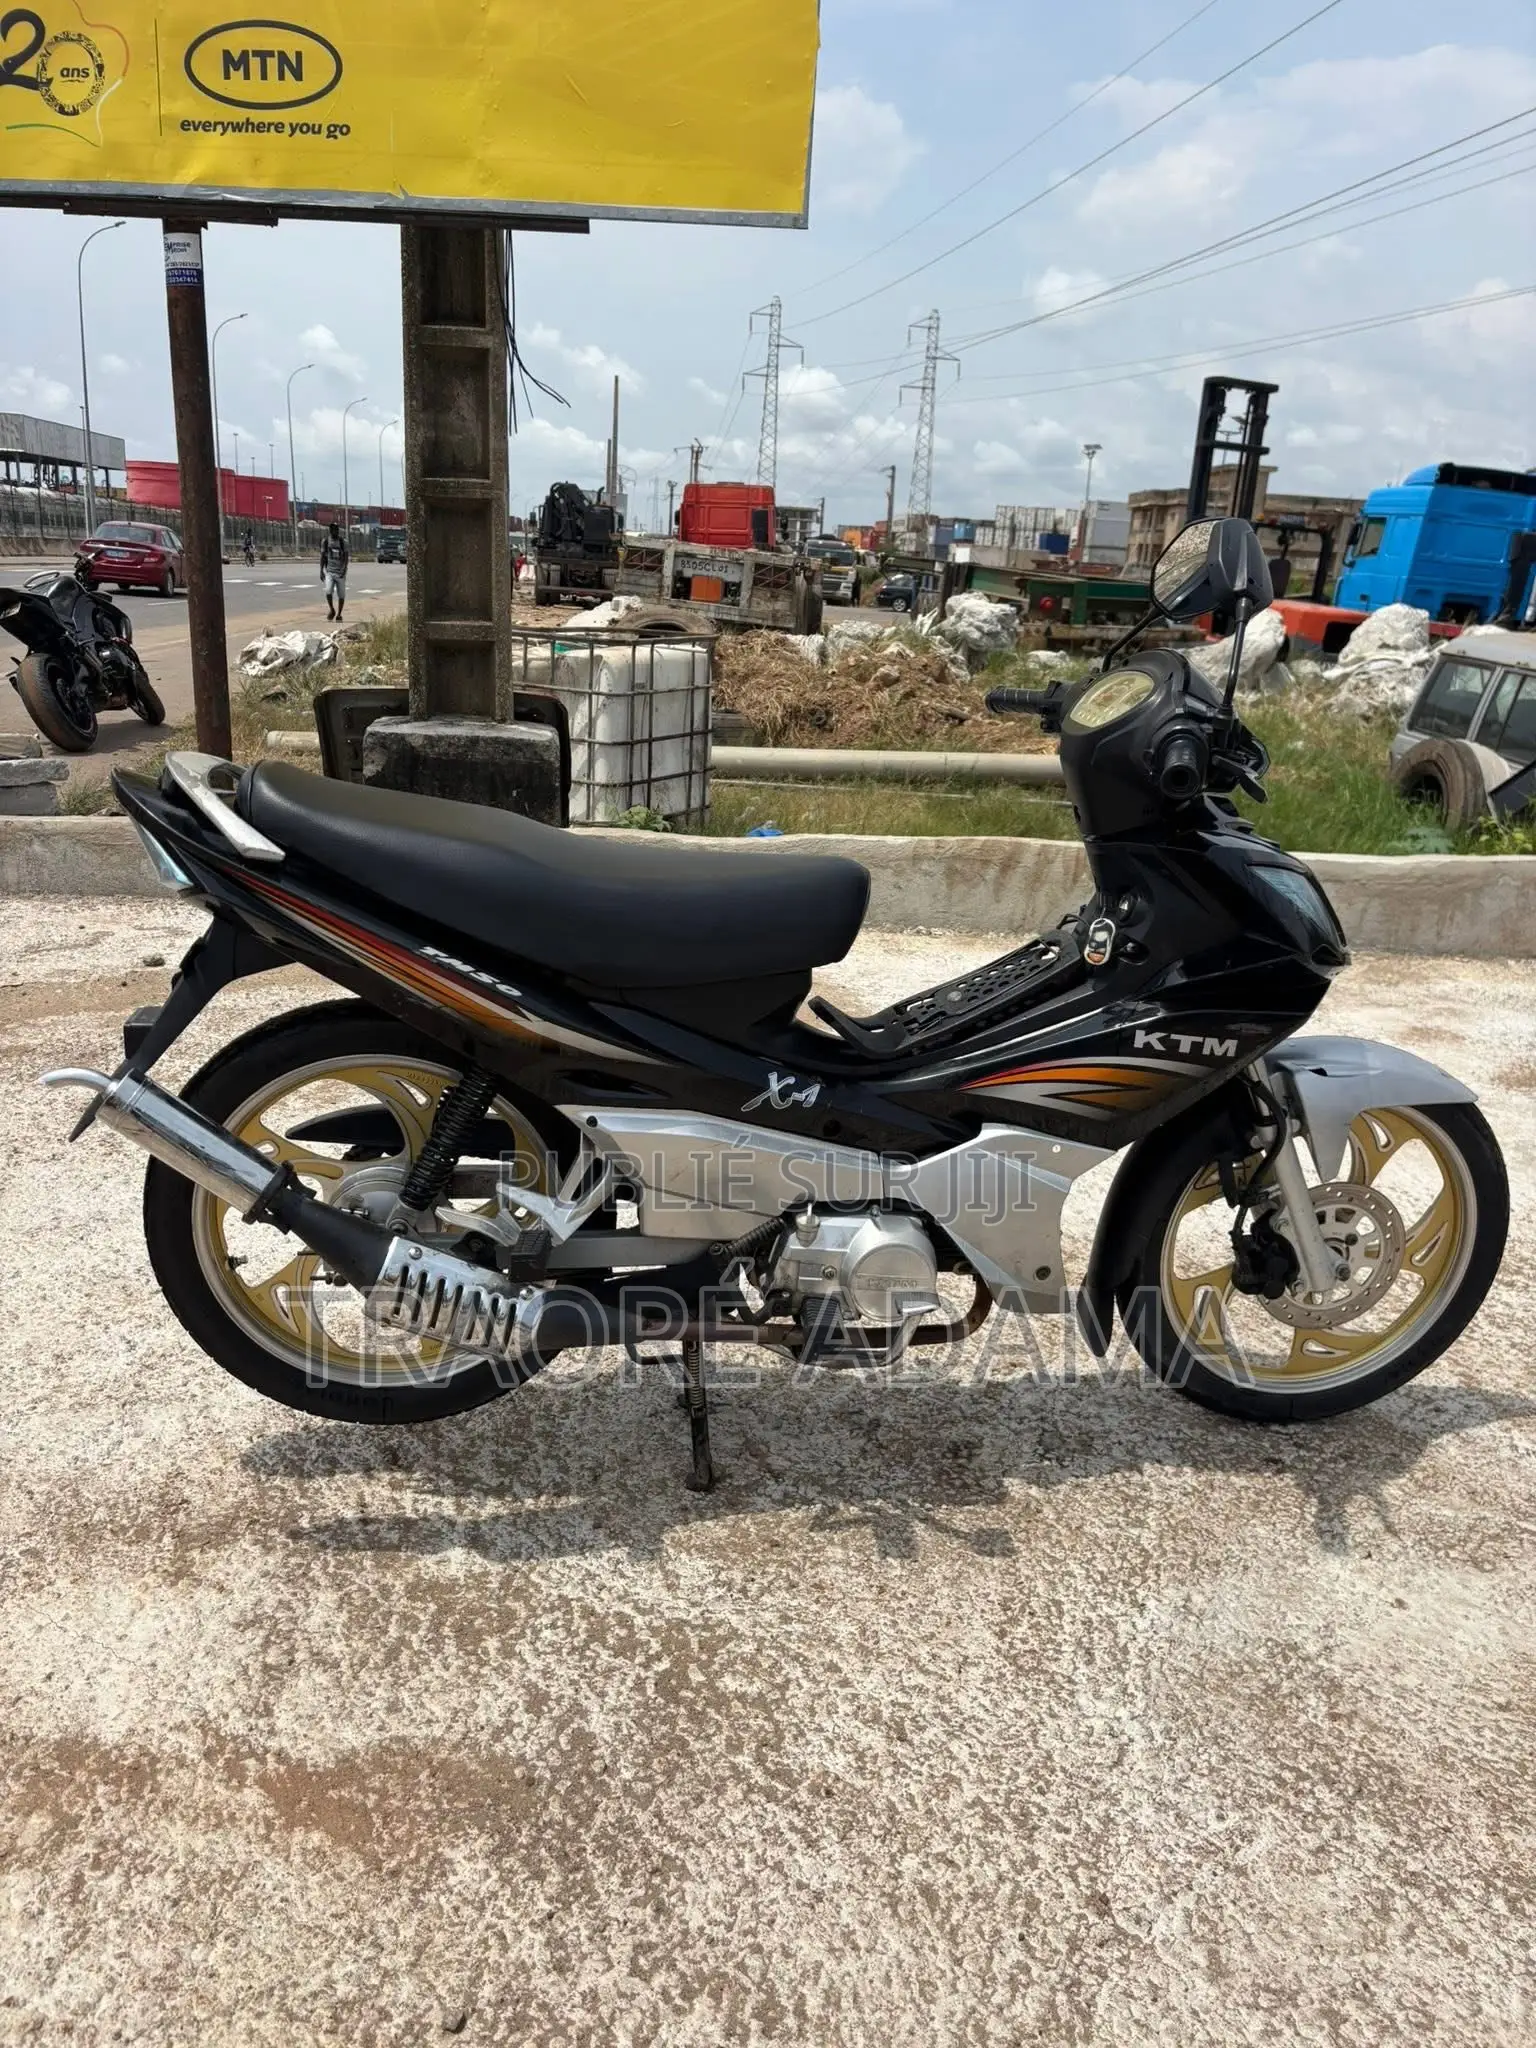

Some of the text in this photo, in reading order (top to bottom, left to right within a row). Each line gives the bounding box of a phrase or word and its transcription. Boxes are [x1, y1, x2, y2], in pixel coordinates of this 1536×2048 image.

[60, 66, 90, 79] ans
[222, 49, 304, 82] MTN
[180, 117, 351, 139] everywhere you go
[1133, 1029, 1238, 1057] KTM
